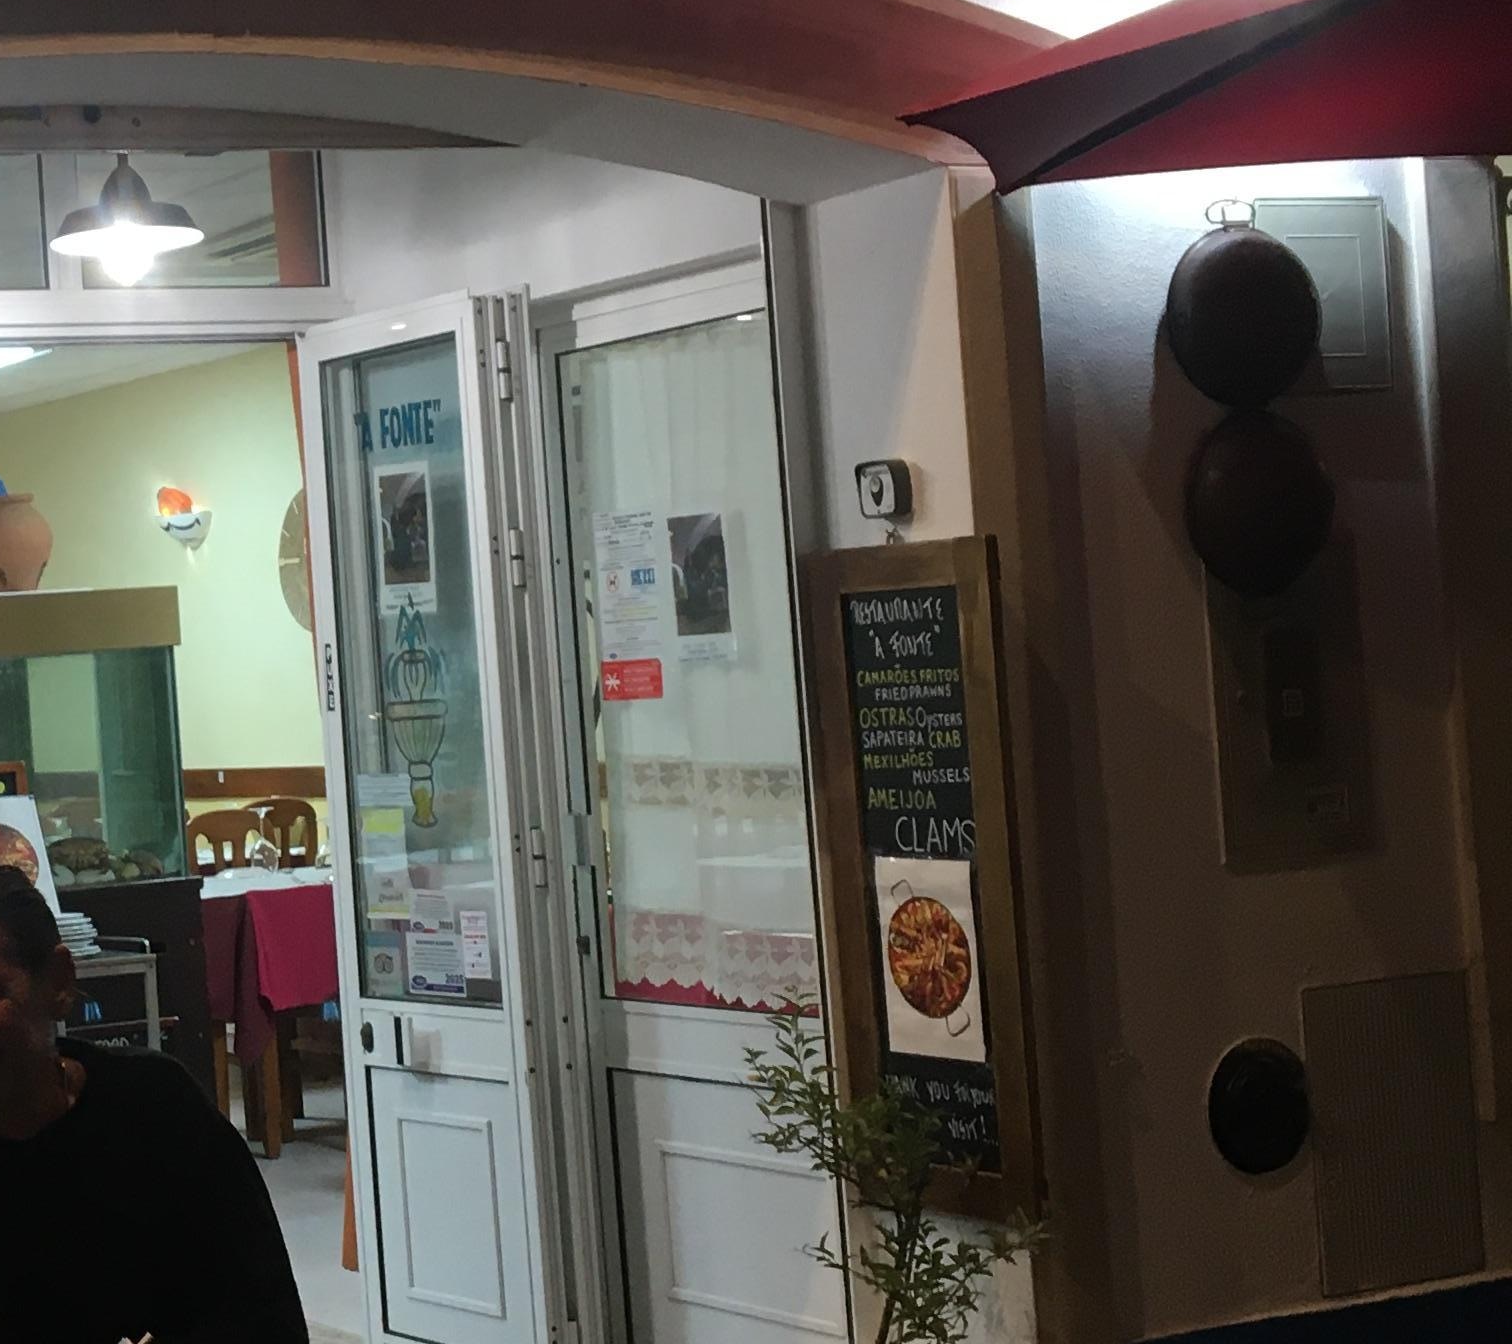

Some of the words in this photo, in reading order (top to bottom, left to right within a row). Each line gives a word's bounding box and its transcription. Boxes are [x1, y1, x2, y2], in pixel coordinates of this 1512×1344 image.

[850, 596, 944, 625] RESTAURANTE
[919, 668, 960, 684] FRITOS
[875, 686, 908, 702] FRIED
[909, 683, 952, 699] PRAWNS
[859, 706, 915, 729] OSTRAS
[862, 730, 925, 749] SAPATEIRA
[929, 729, 962, 748] CRAB
[912, 766, 970, 785] MUSSELS
[867, 786, 937, 810] AMEIJOA
[895, 816, 977, 855] CLAMS
[925, 1080, 950, 1103] YOU
